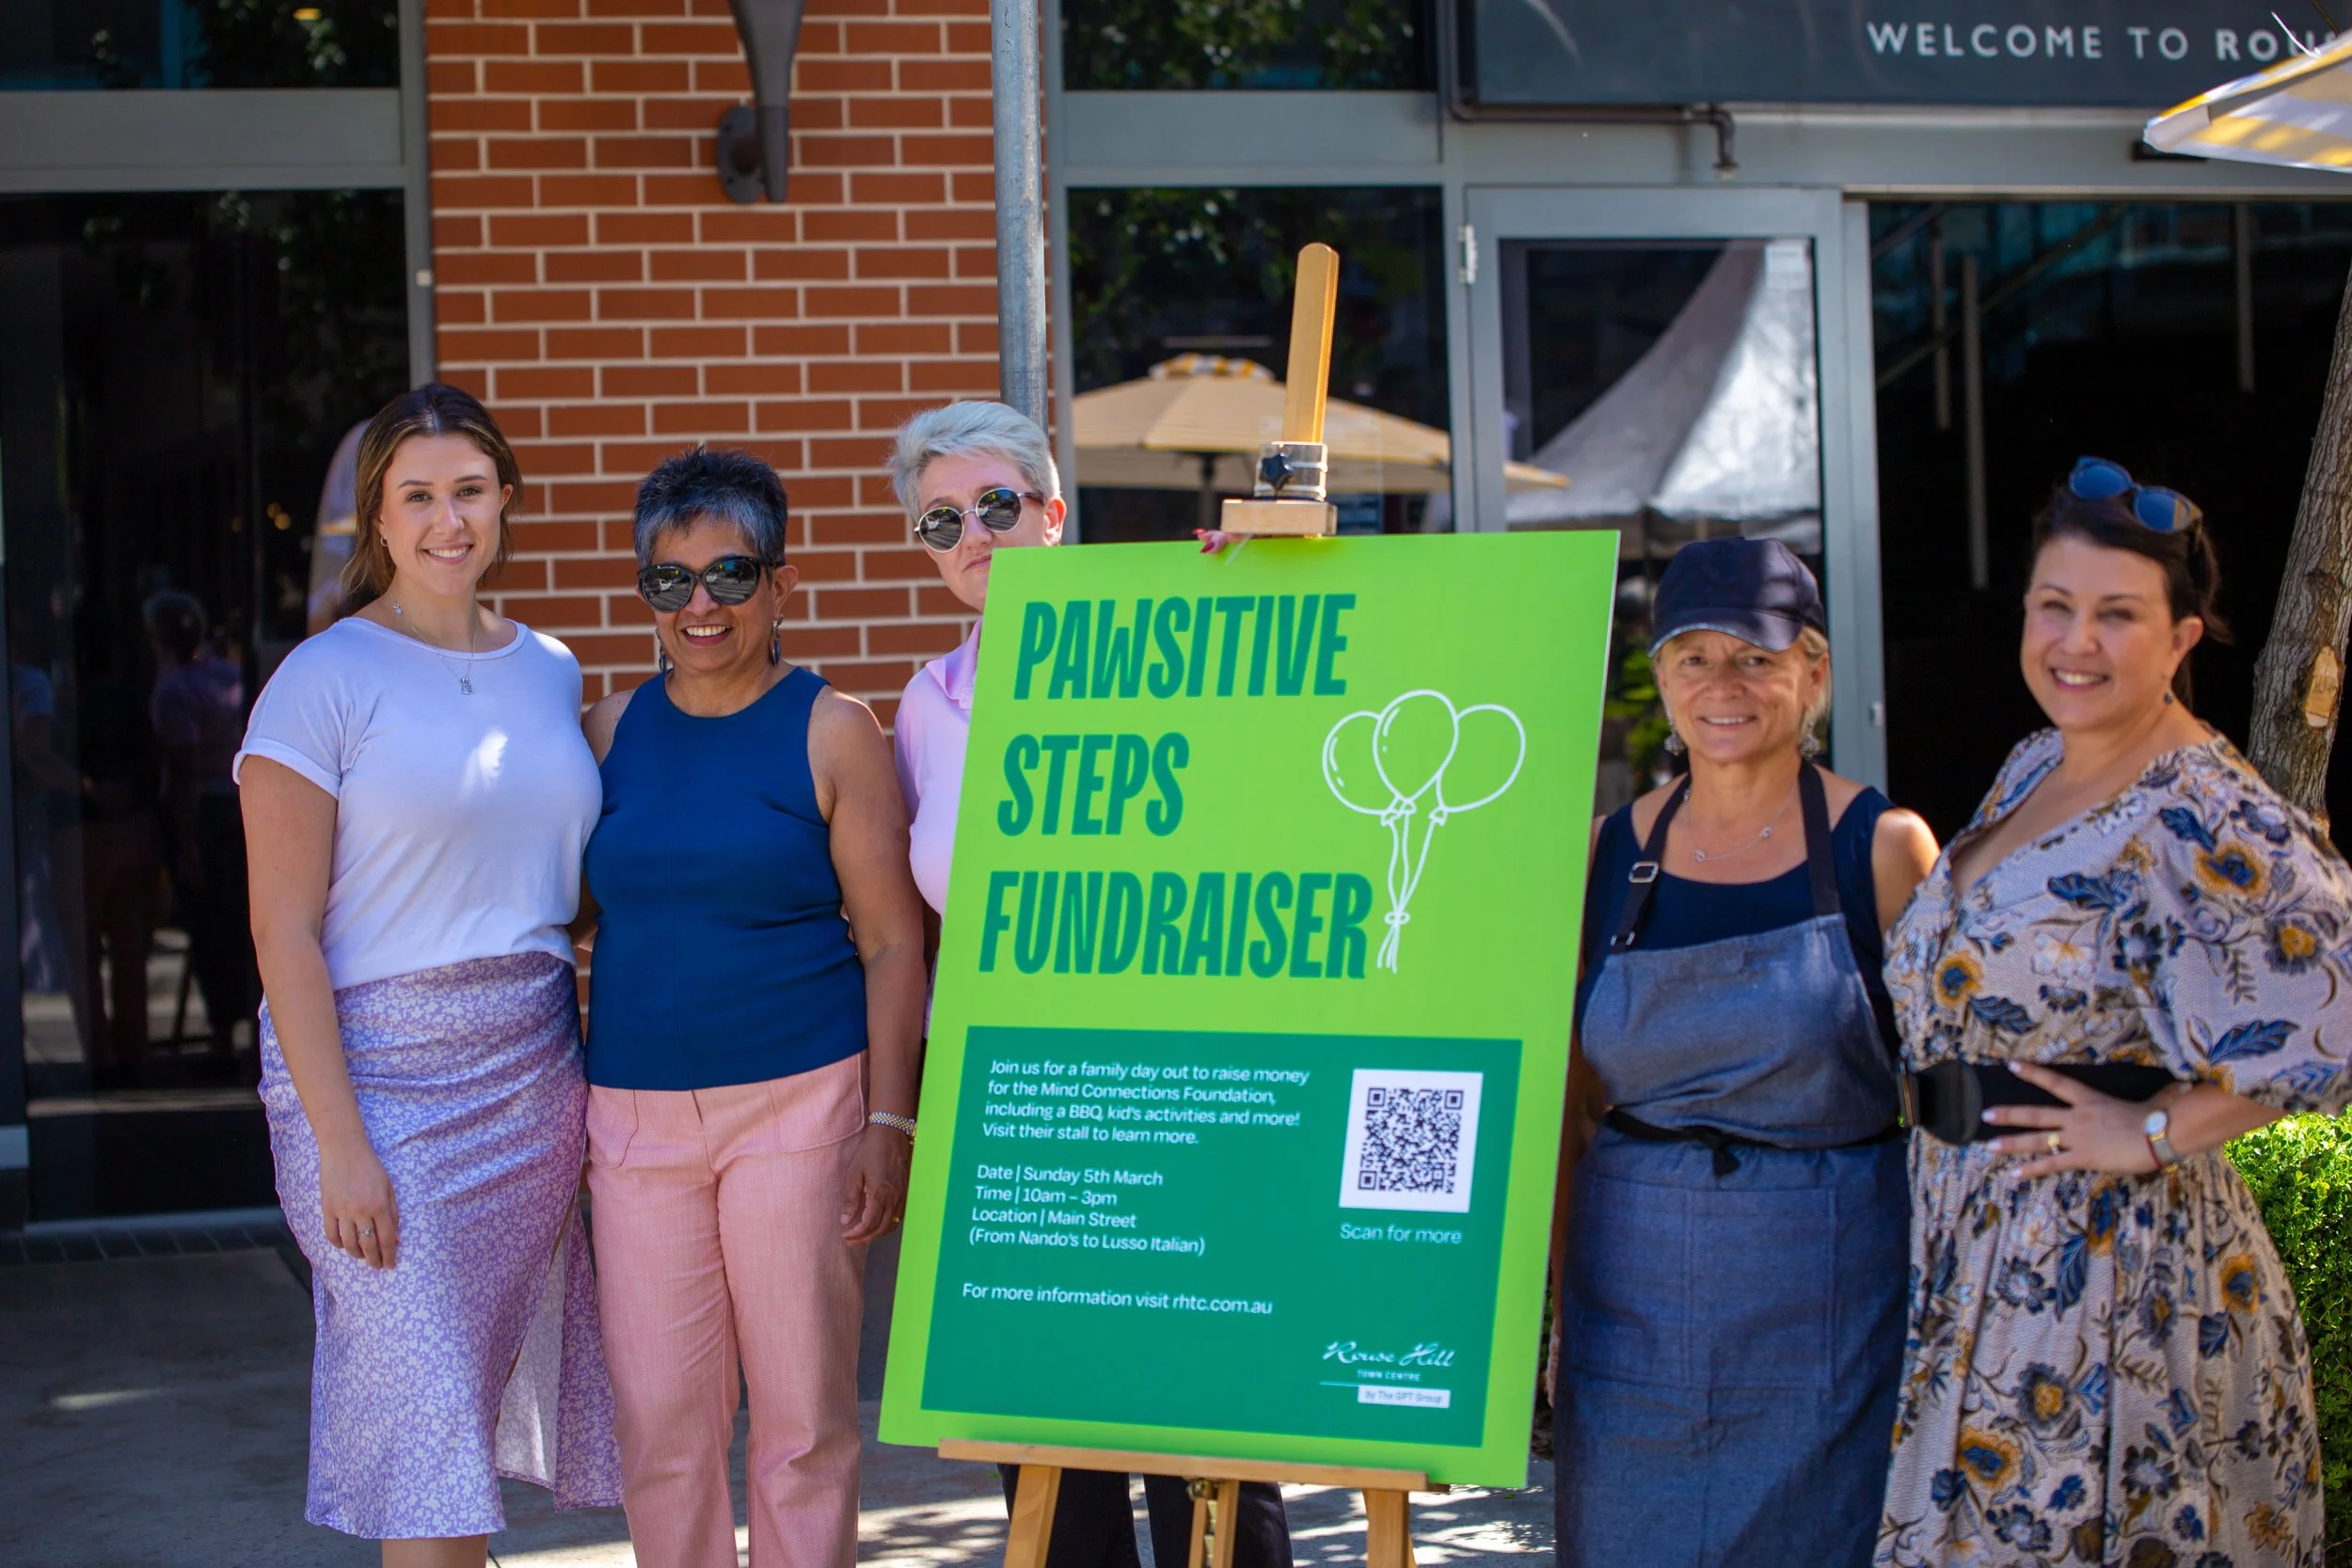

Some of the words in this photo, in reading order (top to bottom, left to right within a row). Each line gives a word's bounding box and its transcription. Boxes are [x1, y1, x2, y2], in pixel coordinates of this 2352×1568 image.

[1866, 22, 2103, 58] WELCOME
[2127, 26, 2188, 60] TO
[1013, 593, 1356, 700] PAWSITIVE
[997, 732, 1190, 837] STEPS
[978, 871, 1374, 979] FUNDRAISER
[990, 1059, 1019, 1075] Join
[1022, 1063, 1040, 1076] us
[1043, 1060, 1066, 1076] for
[1068, 1065, 1078, 1077] a
[1081, 1060, 1129, 1081] family
[1131, 1063, 1160, 1082] day
[1162, 1065, 1189, 1080] out
[1193, 1065, 1209, 1081] to
[1212, 1066, 1250, 1082] raise
[1253, 1069, 1311, 1086] money
[988, 1079, 1009, 1095] for
[1012, 1081, 1038, 1096] the
[1041, 1082, 1079, 1098] Mind
[1082, 1083, 1180, 1101] Connections
[1184, 1086, 1277, 1106] Foundation,
[985, 1101, 1054, 1121] including
[1057, 1106, 1066, 1118] a
[1107, 1104, 1142, 1121] kid's
[1144, 1106, 1216, 1124] activities
[1219, 1109, 1250, 1125] and
[1252, 1112, 1300, 1127] more!
[982, 1122, 1016, 1138] Visit
[1019, 1123, 1055, 1139] their
[1057, 1125, 1089, 1140] stall
[1092, 1127, 1109, 1141] to
[1112, 1127, 1151, 1143] learn
[1153, 1131, 1200, 1145] more.
[977, 1164, 1013, 1180] Date
[1023, 1166, 1081, 1186] Sunday
[1084, 1168, 1110, 1184] 5th
[1113, 1169, 1164, 1186] March
[975, 1185, 1012, 1201] Time
[1023, 1188, 1066, 1204] 10am
[1081, 1190, 1118, 1208] 3pm
[972, 1207, 1037, 1224] Location
[1048, 1210, 1085, 1226] Main
[1089, 1212, 1137, 1228] Street
[969, 1227, 1015, 1245] (From
[1018, 1229, 1079, 1247] Nando's
[1083, 1233, 1099, 1248] to
[1102, 1234, 1148, 1250] Lusso
[1151, 1235, 1205, 1257] Italian)
[1340, 1223, 1383, 1240] Scan
[1388, 1224, 1412, 1242] for
[1415, 1228, 1462, 1244] more
[962, 1282, 988, 1299] For
[992, 1286, 1034, 1302] more
[1037, 1285, 1132, 1307] information
[1136, 1291, 1169, 1309] visit
[1173, 1292, 1273, 1315] rhtc.com.au
[1322, 1340, 1394, 1364] Rouse
[1399, 1341, 1455, 1367] Hill
[1357, 1370, 1383, 1379] TOWN
[1385, 1370, 1421, 1382] CENTRE
